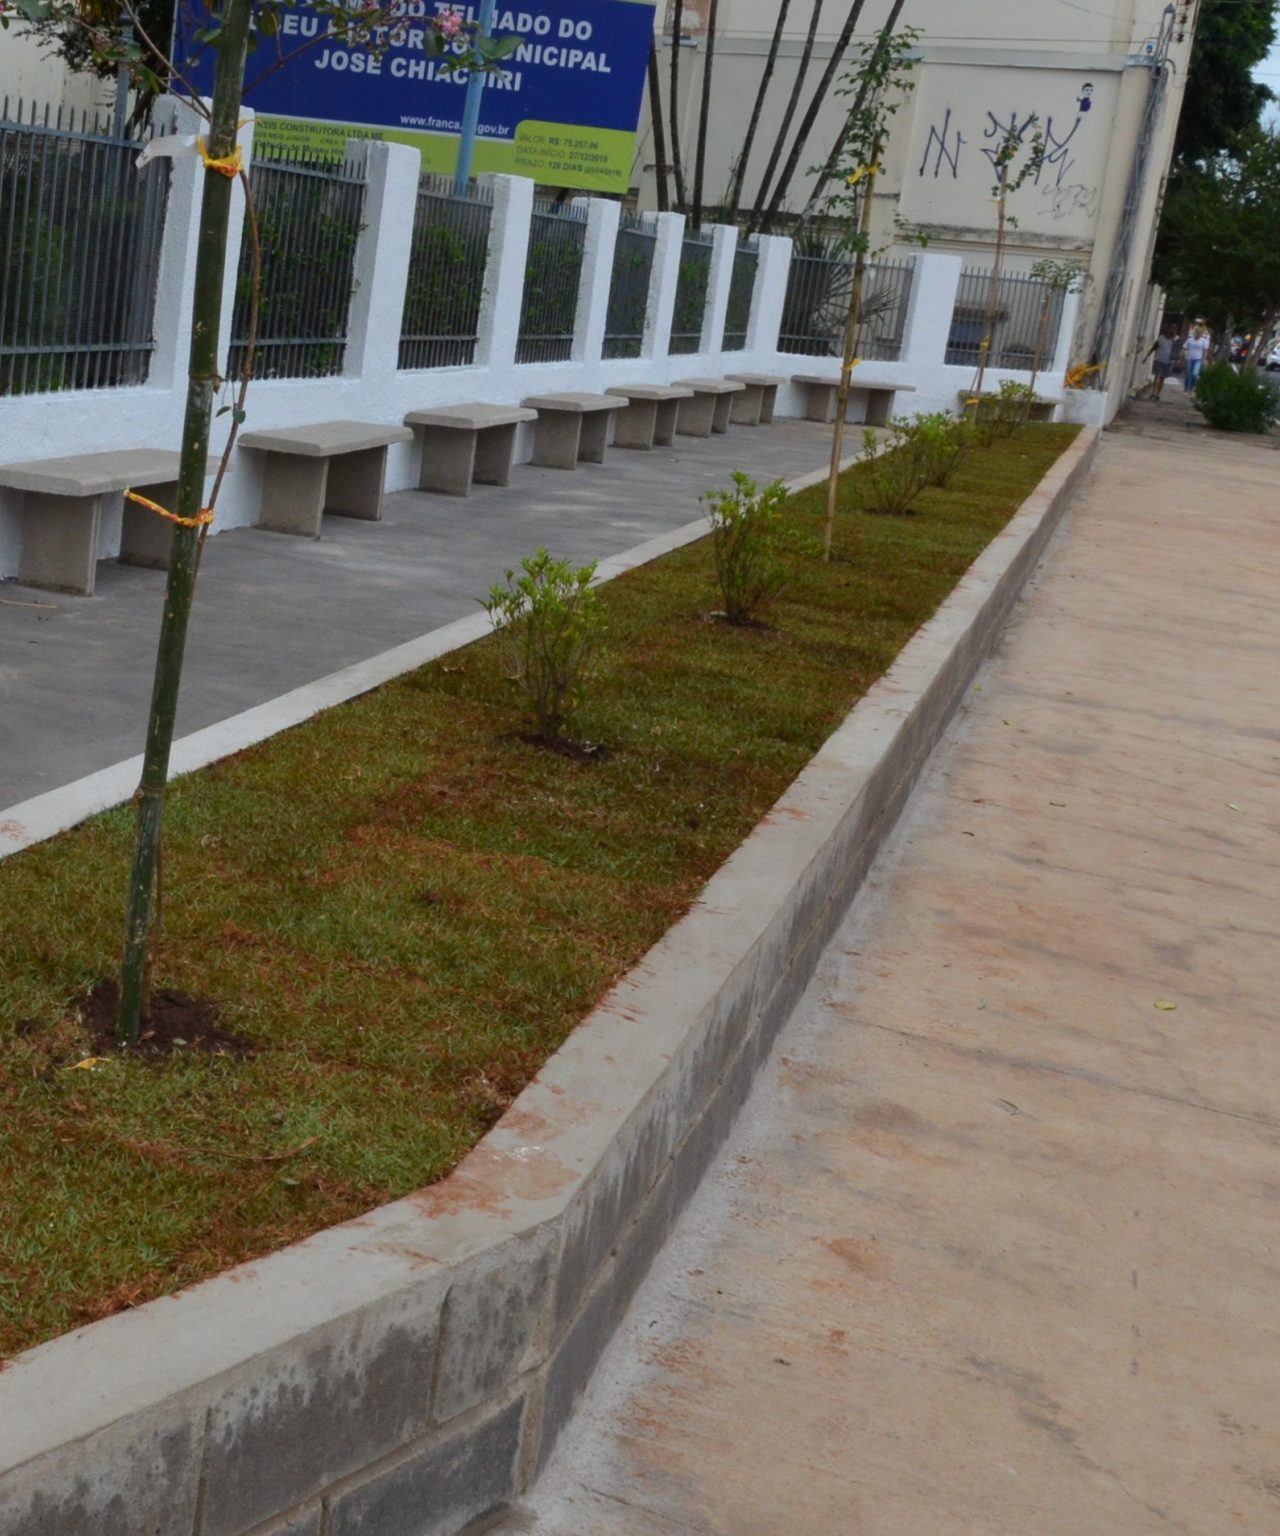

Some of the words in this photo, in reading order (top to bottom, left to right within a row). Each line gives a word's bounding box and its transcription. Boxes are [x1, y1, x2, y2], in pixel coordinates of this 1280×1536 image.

[558, 18, 593, 41] DO
[494, 40, 612, 73] NICIPAL
[280, 122, 345, 137] CONSTRUTORA
